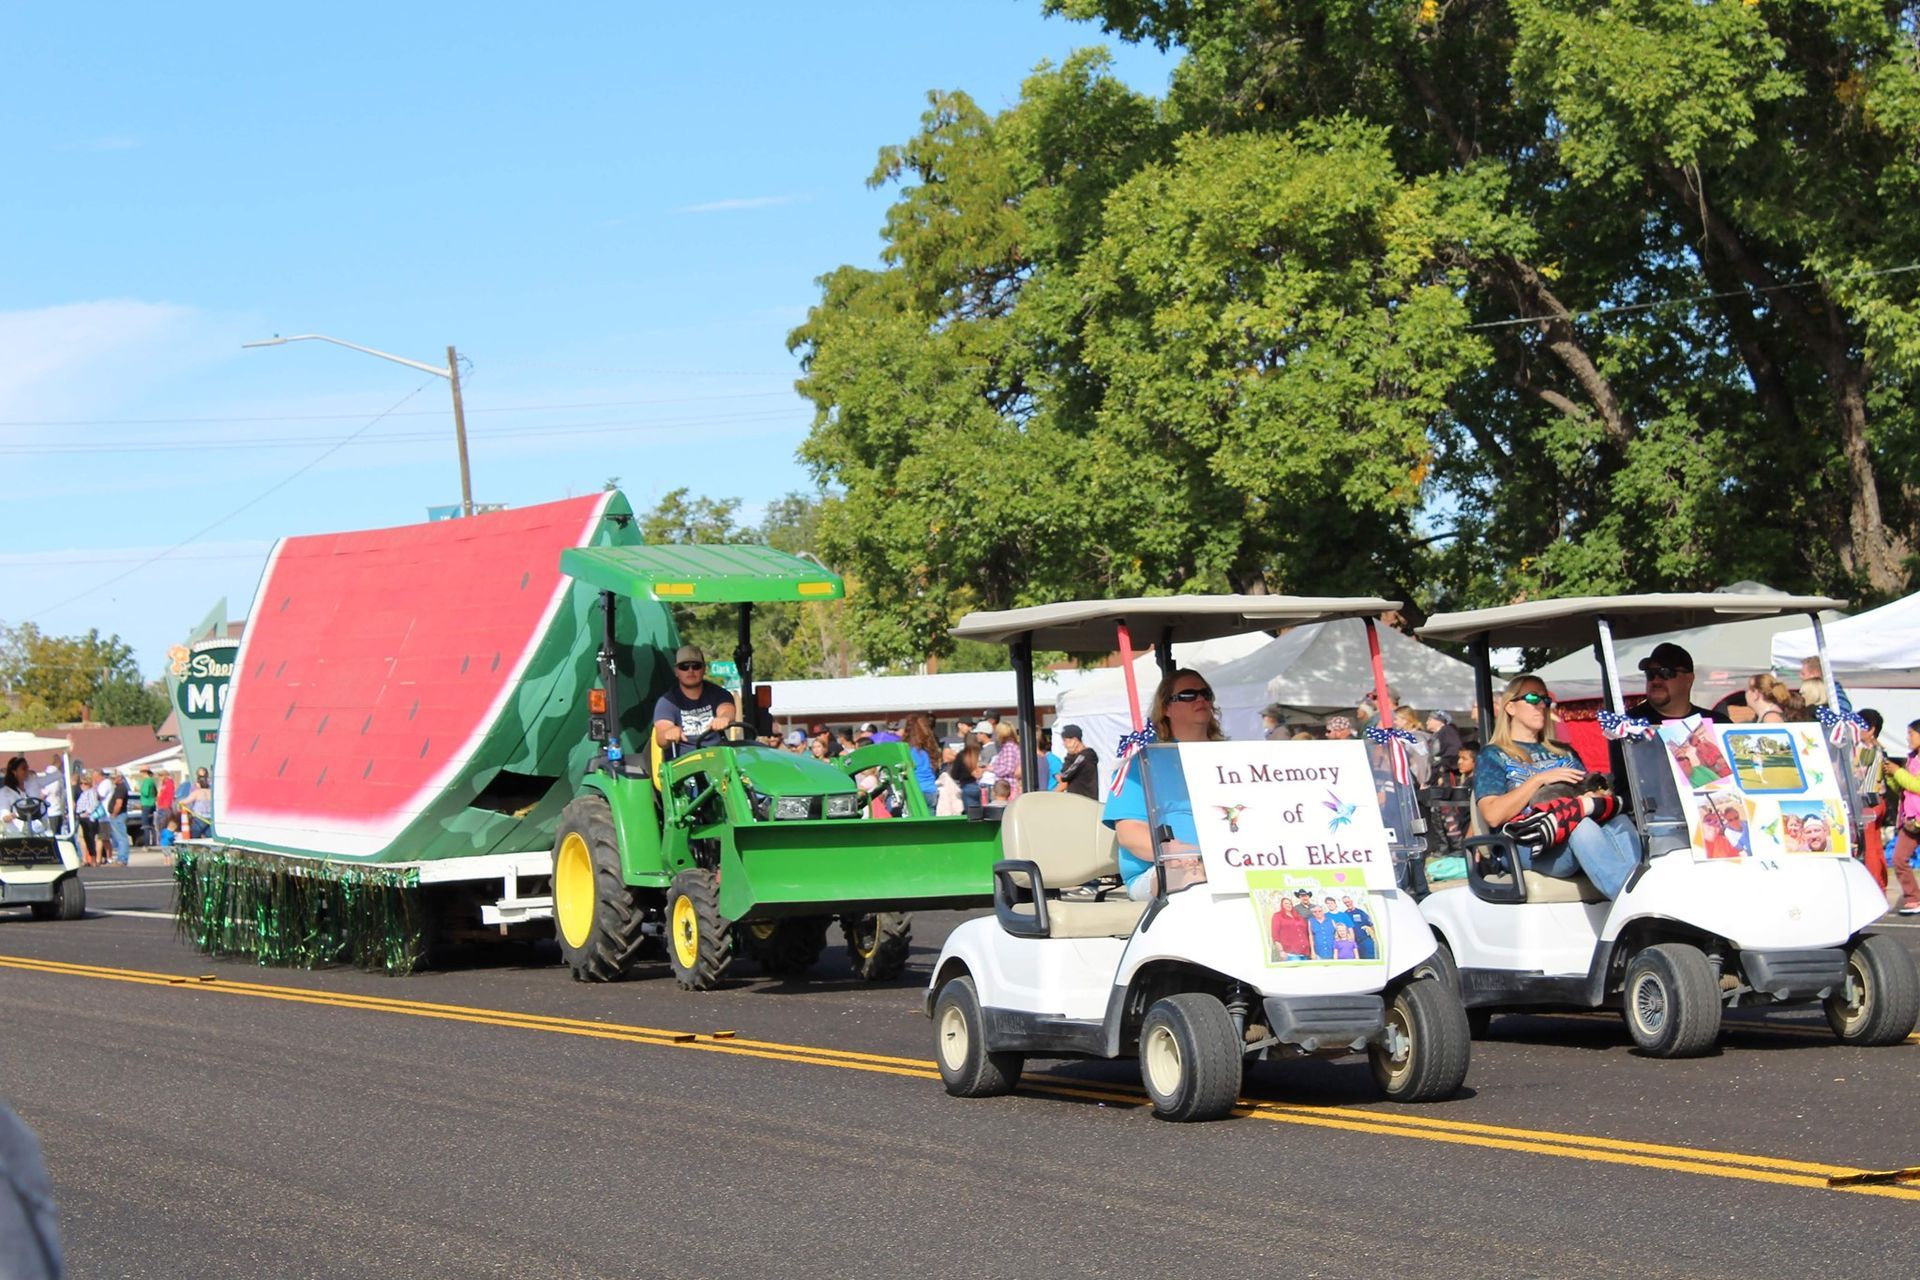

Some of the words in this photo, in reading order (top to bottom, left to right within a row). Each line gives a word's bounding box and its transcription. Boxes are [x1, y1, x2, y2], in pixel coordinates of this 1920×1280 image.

[1216, 765, 1243, 785] In
[1248, 763, 1340, 785] Memory
[1283, 803, 1304, 824] of
[1224, 845, 1288, 868] Carol
[1306, 844, 1374, 866] Ekker
